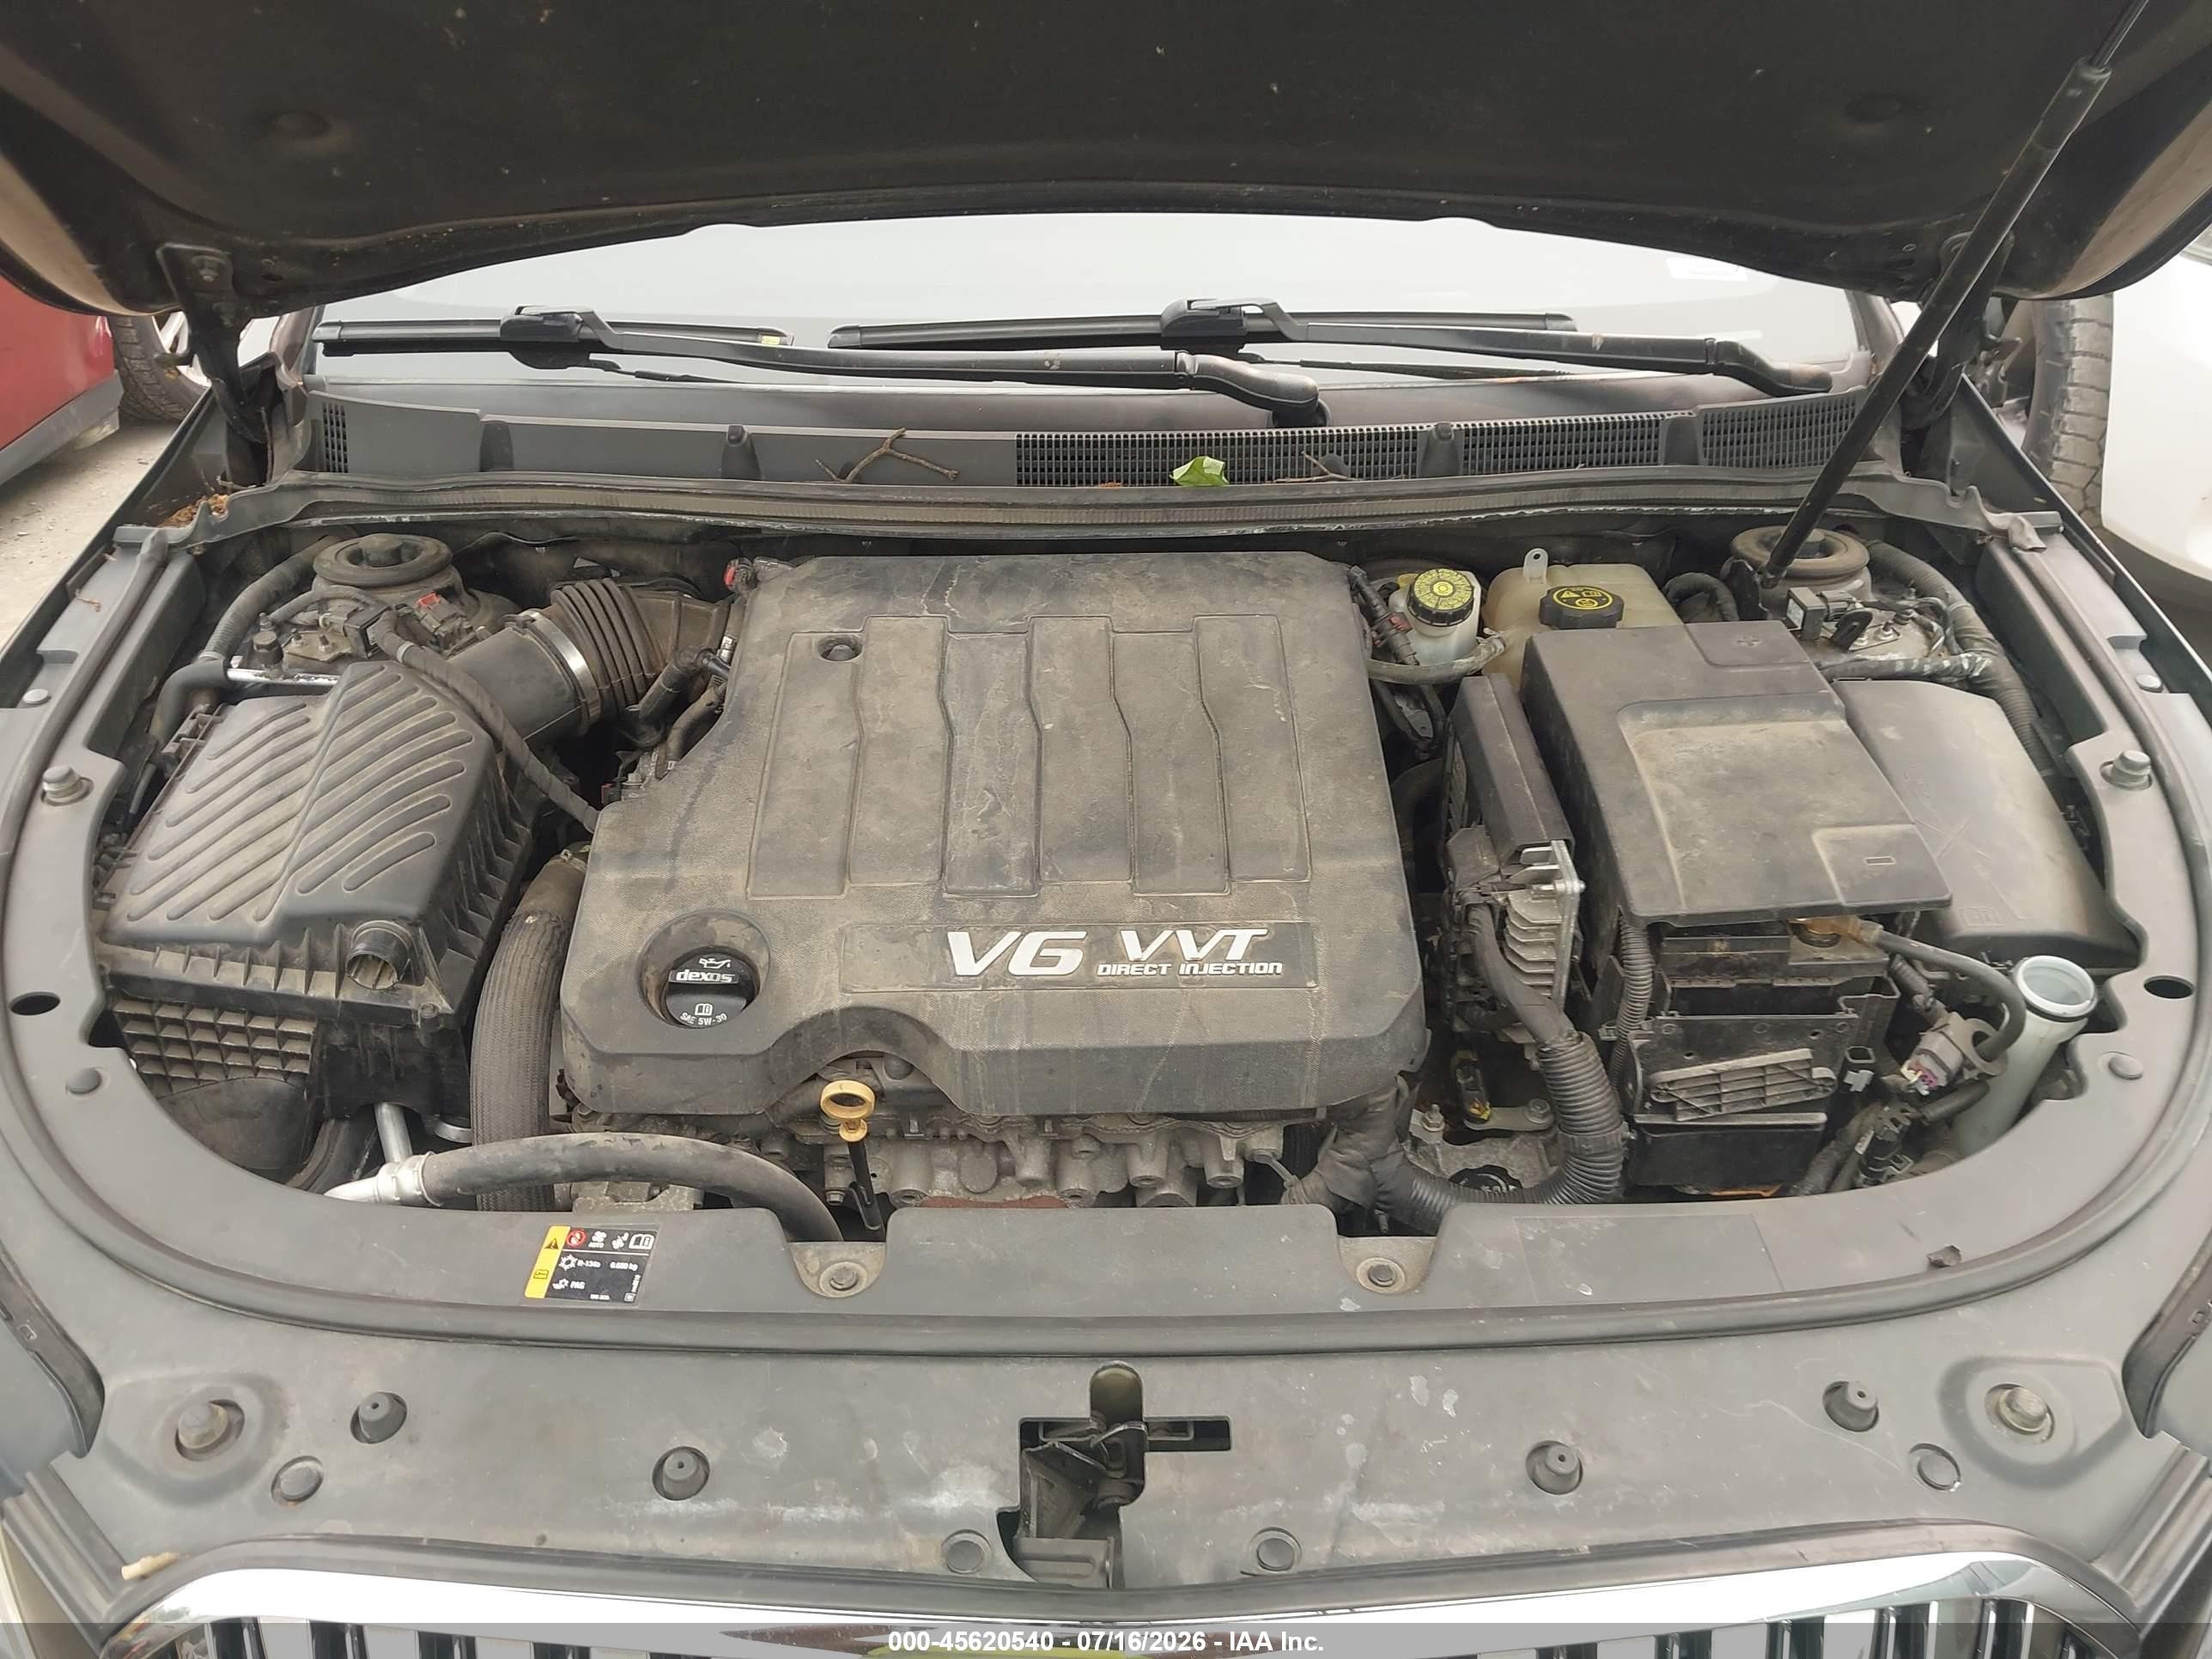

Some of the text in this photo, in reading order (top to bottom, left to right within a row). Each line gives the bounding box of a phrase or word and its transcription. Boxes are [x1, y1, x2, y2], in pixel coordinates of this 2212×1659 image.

[946, 928, 1269, 976] V6 VVT
[676, 969, 736, 983] dexos
[1096, 962, 1283, 976] DIRECT INJECTION
[679, 1012, 727, 1026] SAE 5W-30
